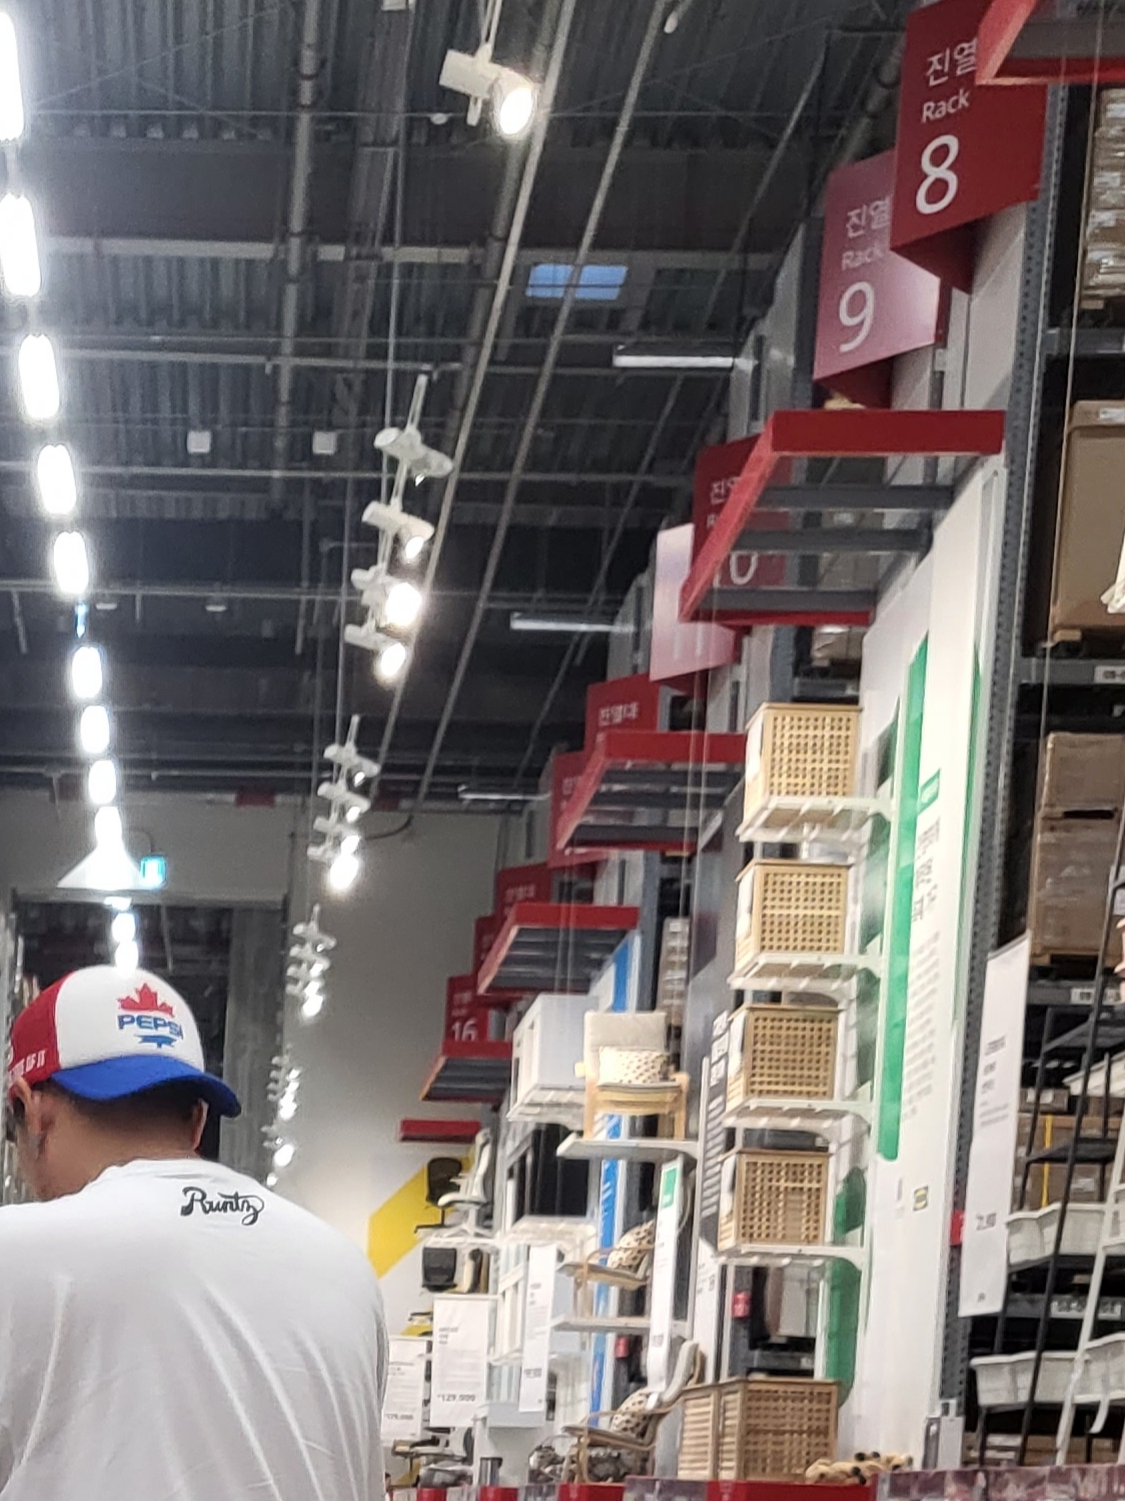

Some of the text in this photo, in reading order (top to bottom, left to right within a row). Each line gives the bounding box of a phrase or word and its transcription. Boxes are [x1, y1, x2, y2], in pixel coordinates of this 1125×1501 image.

[926, 37, 977, 87] 진열
[921, 88, 970, 124] Rack
[915, 134, 959, 215] 8
[846, 196, 890, 238] 진열
[841, 246, 884, 271] Rack
[839, 281, 874, 353] 9
[117, 1014, 184, 1040] PEPSI
[452, 1018, 477, 1041] 16
[180, 1186, 265, 1226] Runtz
